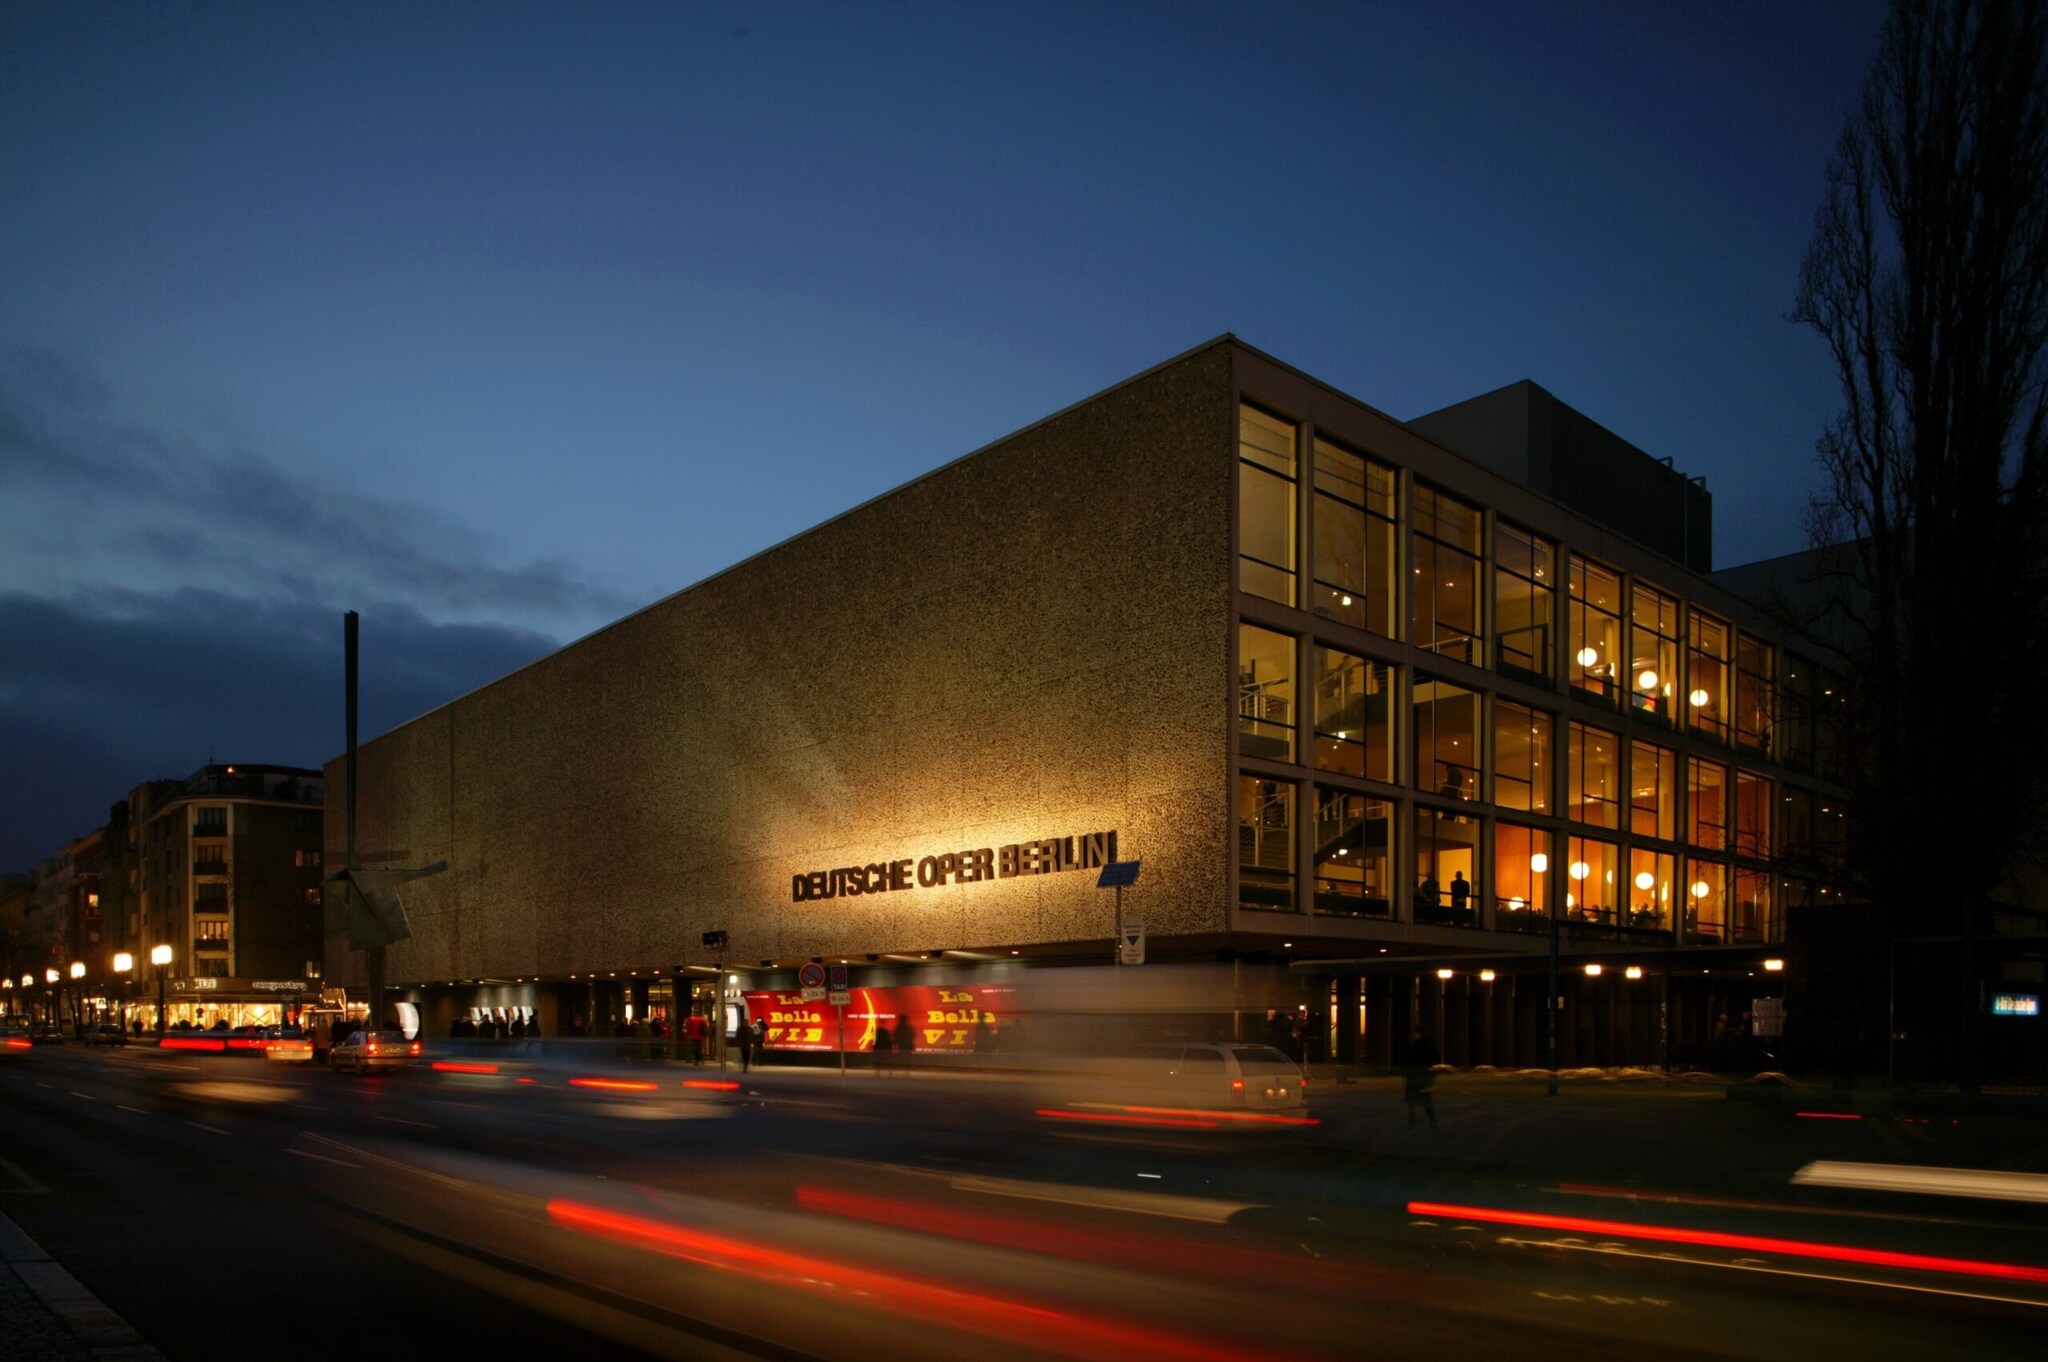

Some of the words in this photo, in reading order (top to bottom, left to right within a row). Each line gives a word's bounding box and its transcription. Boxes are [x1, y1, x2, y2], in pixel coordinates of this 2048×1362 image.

[793, 858, 913, 902] DEUTSCHE
[917, 847, 995, 888] OPER
[999, 830, 1117, 879] BERLIN
[777, 995, 804, 1005] La
[938, 990, 974, 1003] La
[768, 1028, 823, 1042] VIE
[923, 1029, 997, 1046] VI
